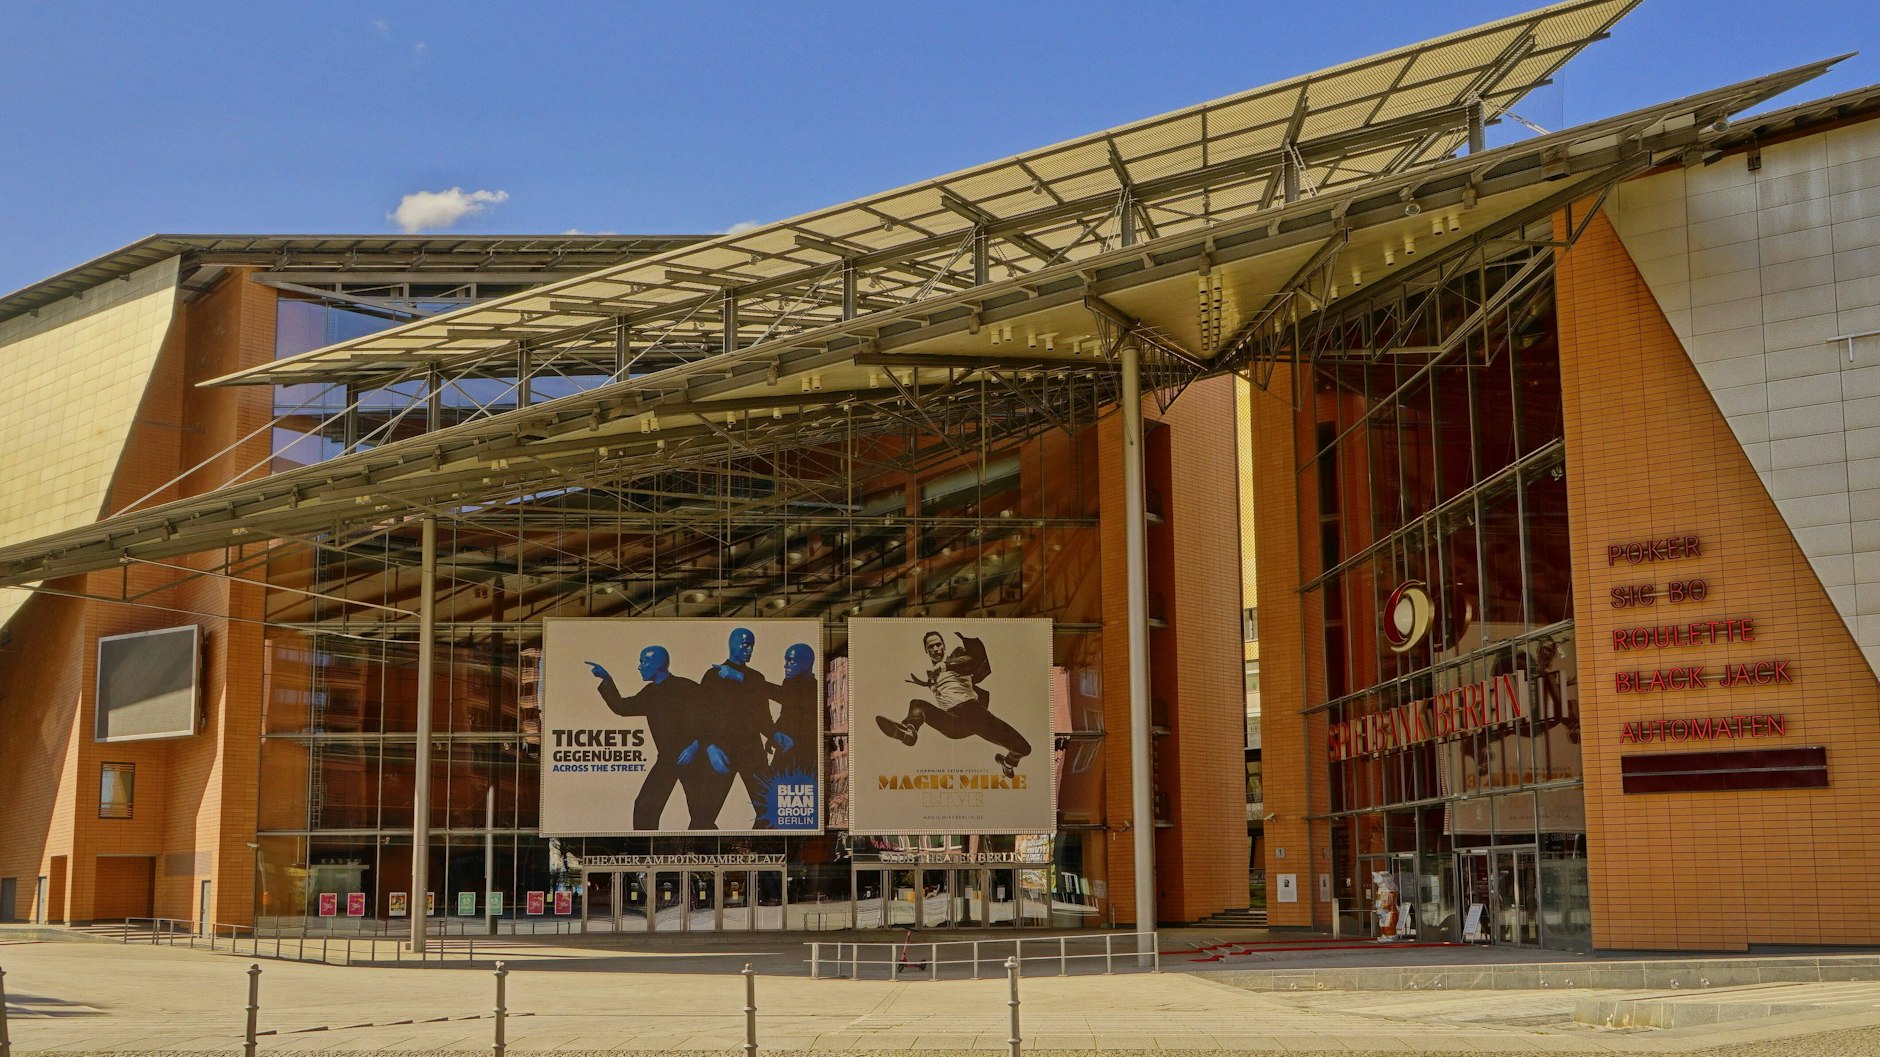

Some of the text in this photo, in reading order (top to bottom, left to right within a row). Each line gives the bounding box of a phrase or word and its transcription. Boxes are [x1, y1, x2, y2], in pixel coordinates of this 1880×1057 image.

[1607, 536, 1702, 566] POKER
[1610, 579, 1708, 608] SIC BO
[1613, 619, 1755, 651] ROULETTE
[1615, 660, 1793, 693] BLACK JACK
[1328, 671, 1523, 763] SPIELBANK BERLIN
[1619, 714, 1786, 744] AUTOMATEN
[552, 729, 645, 747] TICKETS
[553, 747, 647, 762] GEGENÜBER.
[553, 764, 647, 772] ACROSS THE STREET.
[878, 774, 1027, 790] MAGIC MIKE
[777, 784, 814, 796] BLUE
[777, 795, 814, 808] MAN
[777, 807, 814, 817] GROUP
[777, 816, 814, 825] BERLIN
[584, 854, 787, 865] THEATER AM POTSDAMER PLATZ
[978, 852, 1023, 863] BERLIN
